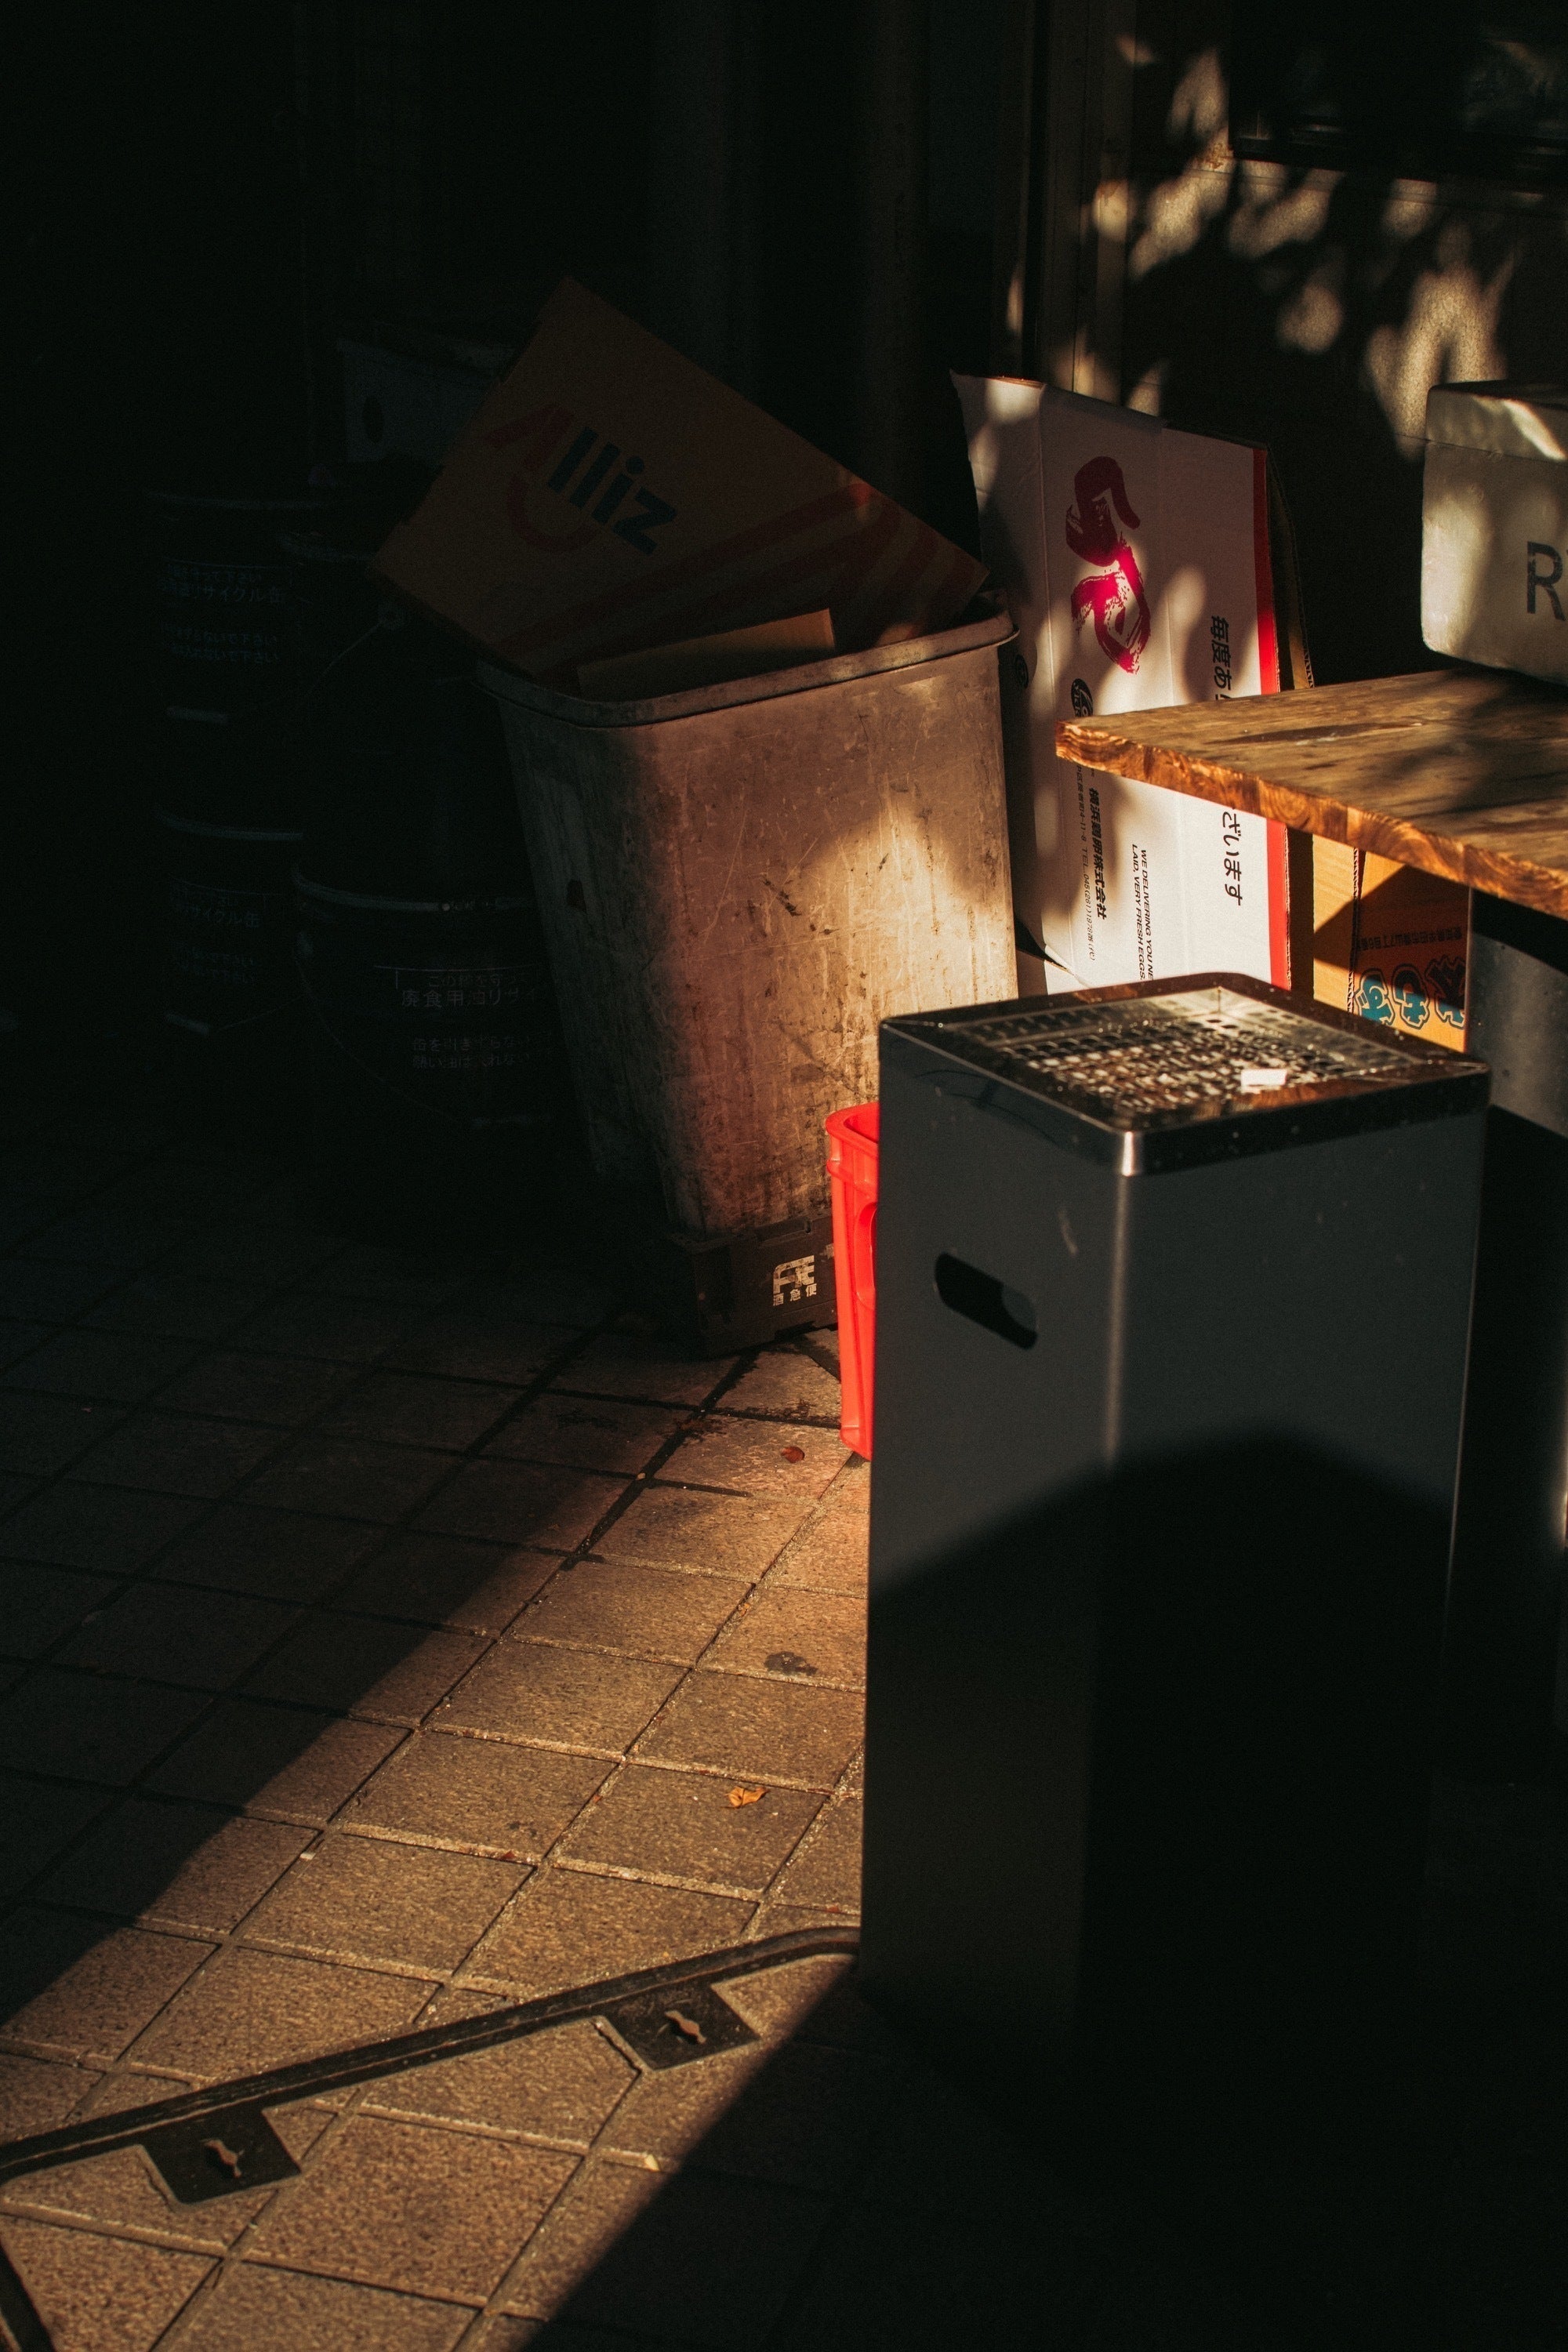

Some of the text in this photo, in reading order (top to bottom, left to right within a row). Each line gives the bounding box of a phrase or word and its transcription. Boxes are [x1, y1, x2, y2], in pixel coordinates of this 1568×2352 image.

[1527, 541, 1568, 622] R
[1141, 849, 1148, 869] WE
[1142, 869, 1152, 936] DELIVERING
